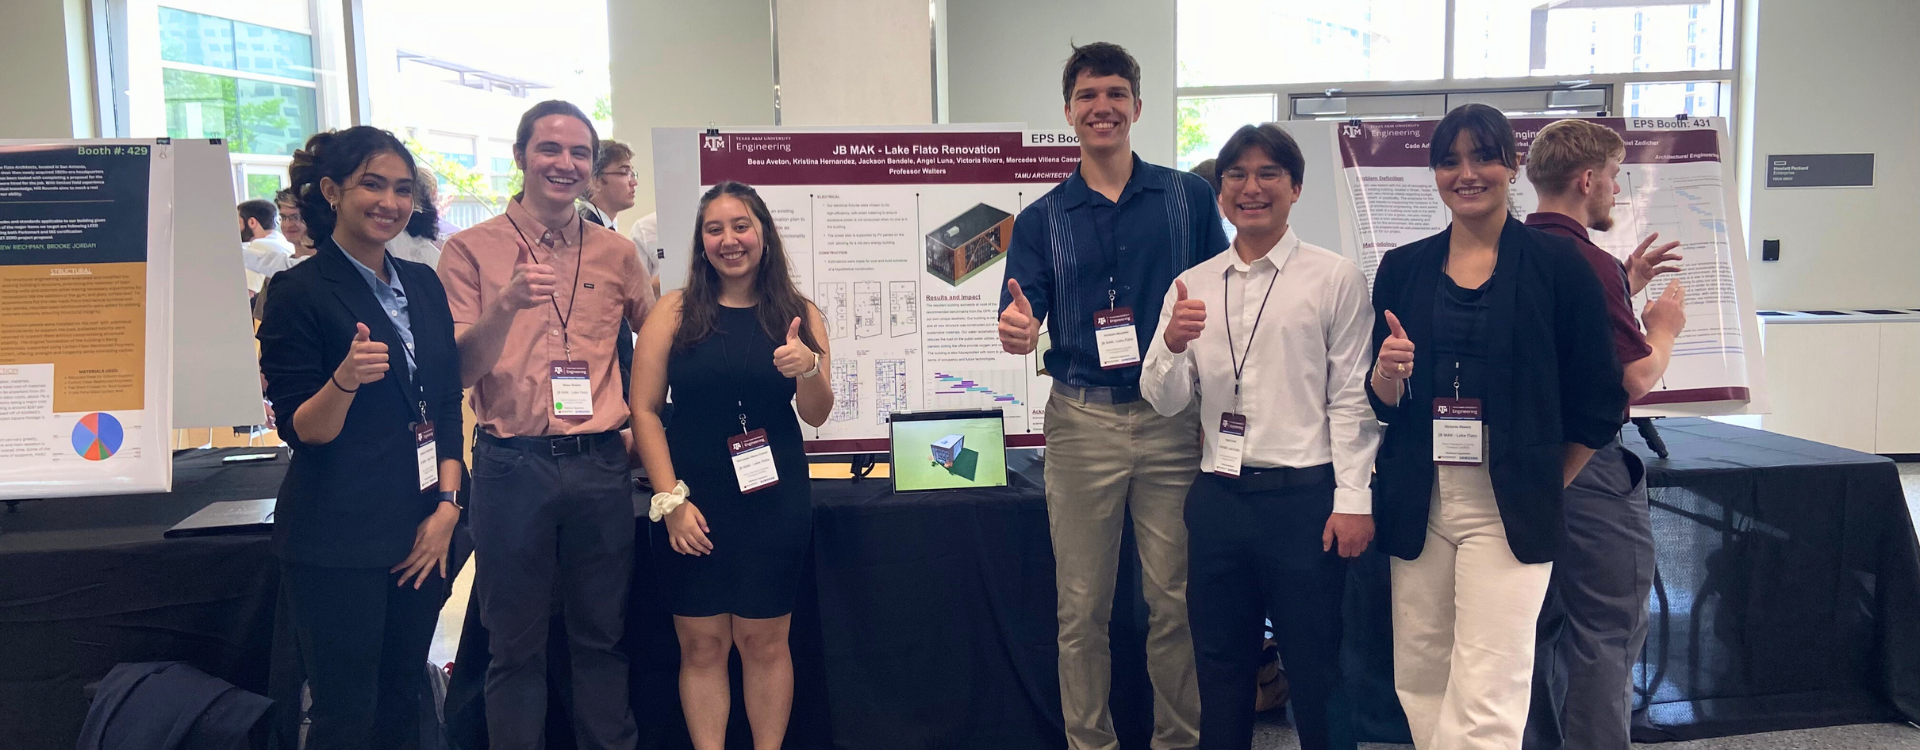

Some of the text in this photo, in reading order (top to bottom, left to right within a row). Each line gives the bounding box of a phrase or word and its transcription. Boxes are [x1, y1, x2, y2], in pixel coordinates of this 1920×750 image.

[1634, 119, 1711, 128] EPS Booth: 431
[1372, 129, 1420, 138] Engineering
[1032, 134, 1080, 143] EPS Boo
[78, 147, 111, 155] Booth
[736, 143, 792, 152] Engineering
[833, 146, 847, 154] JB
[850, 146, 875, 154] MAK
[885, 146, 909, 154] Lake
[913, 146, 938, 154] Flato
[942, 145, 1000, 154] Renovation
